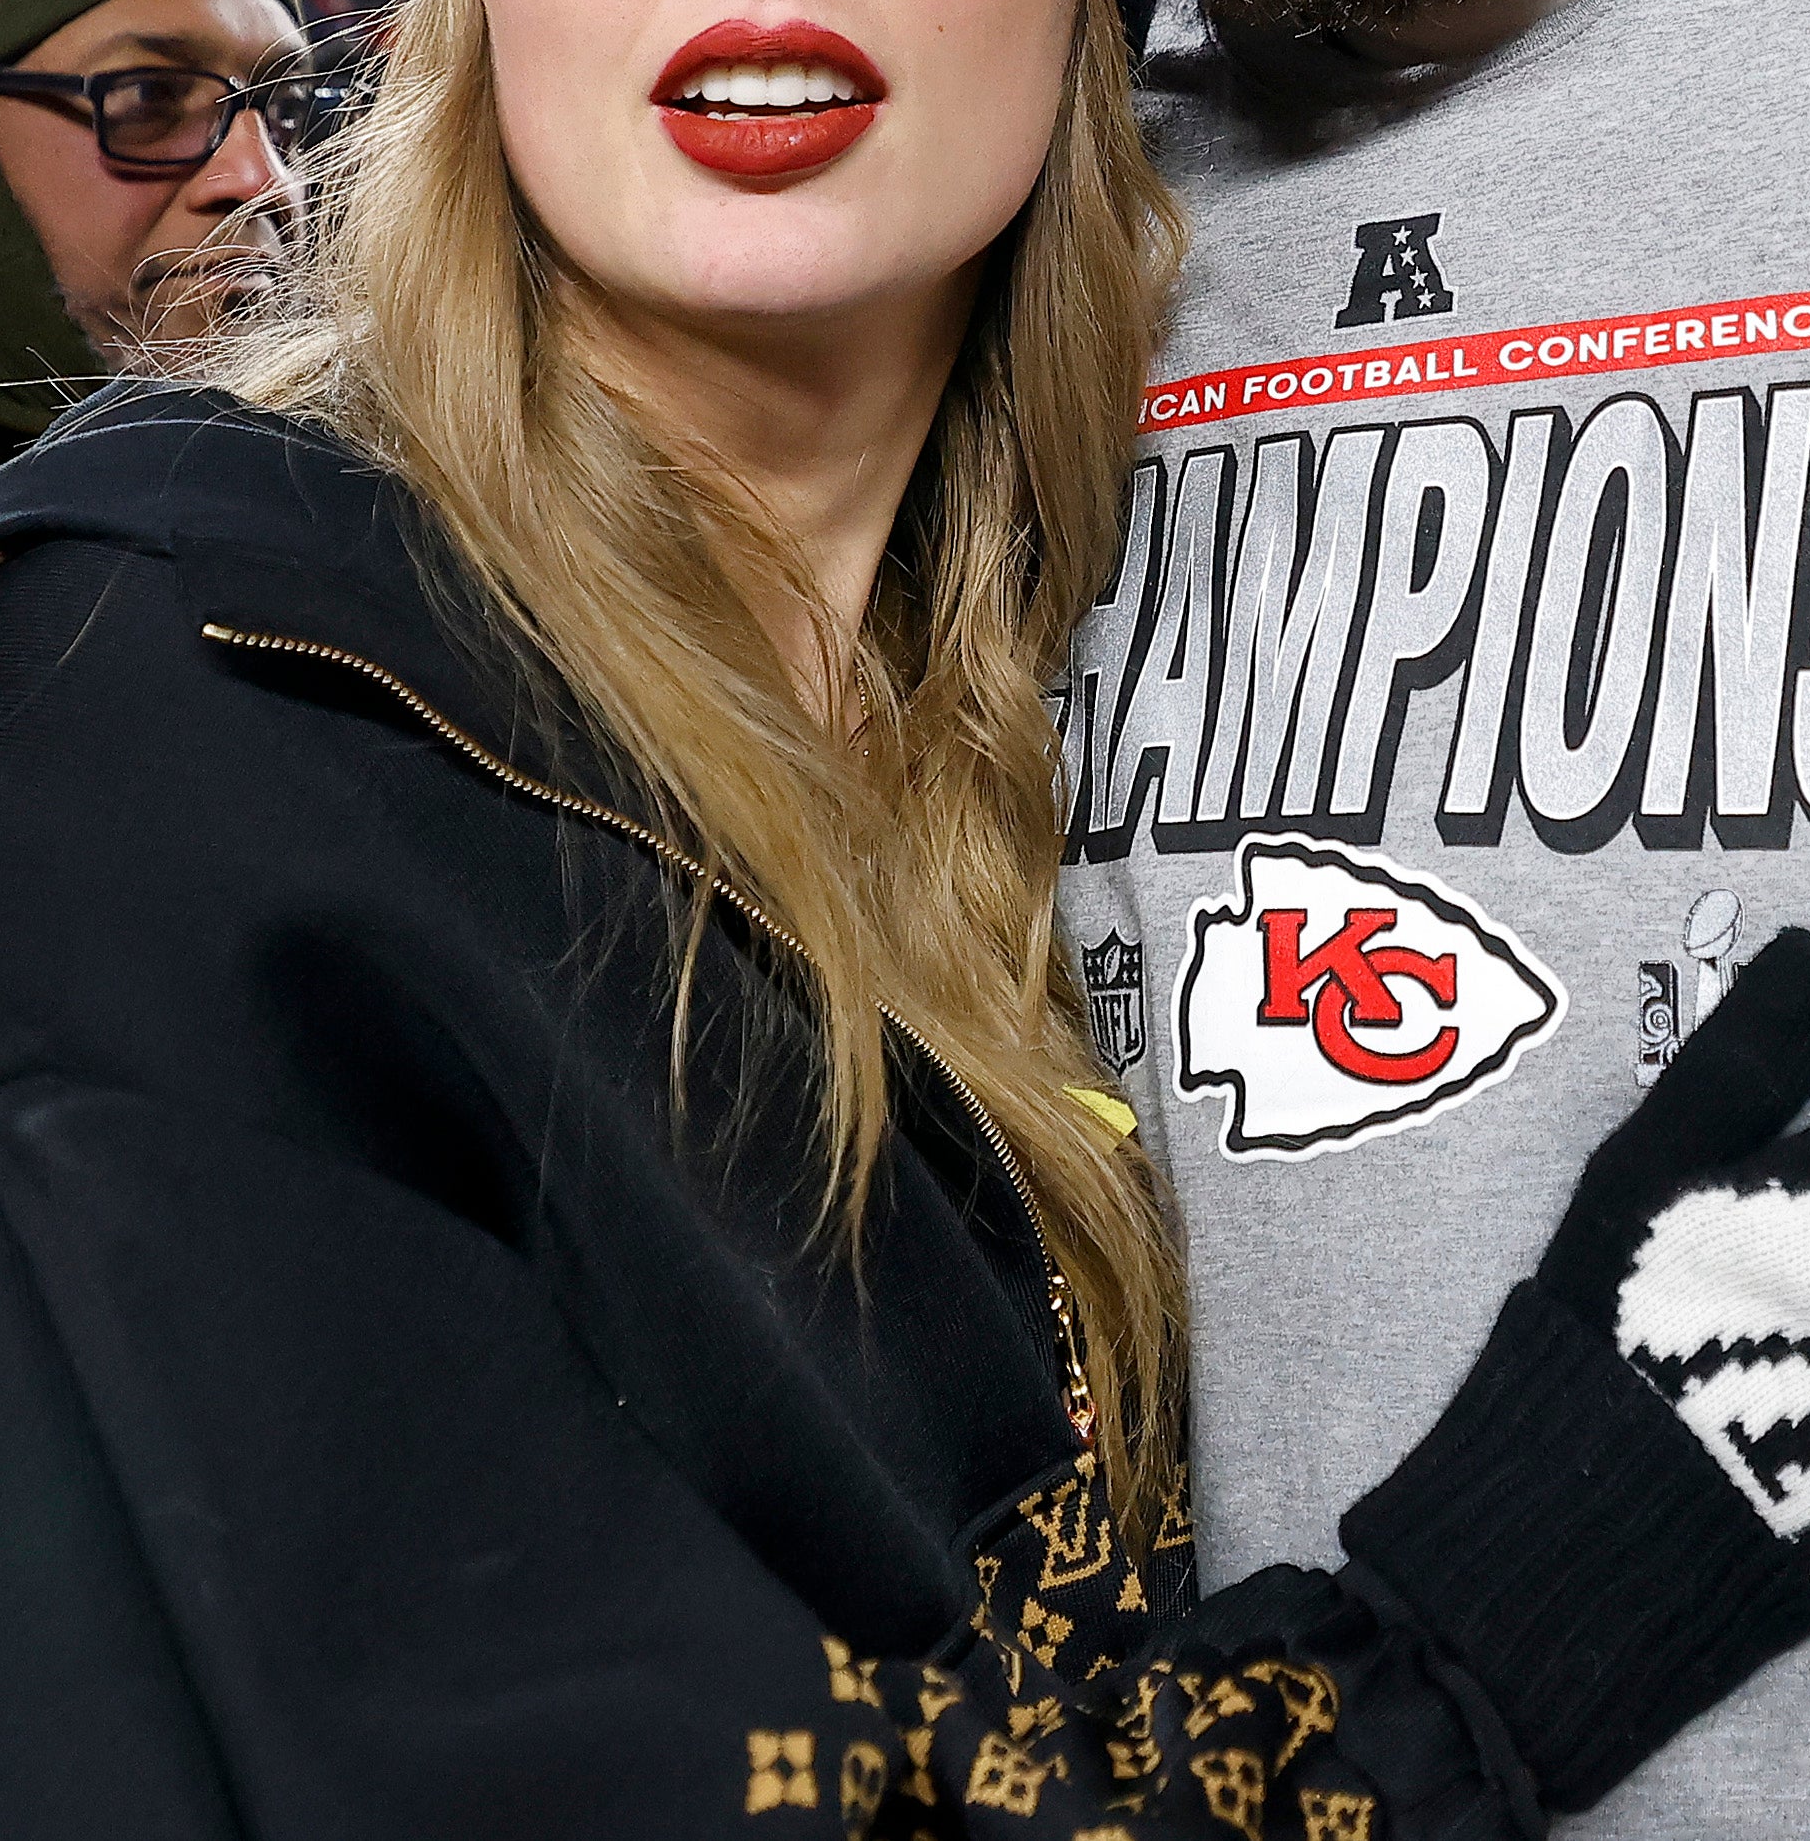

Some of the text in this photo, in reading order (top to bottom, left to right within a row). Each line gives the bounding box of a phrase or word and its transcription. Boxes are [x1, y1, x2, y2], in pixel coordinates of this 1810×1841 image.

[1334, 213, 1455, 328] A
[1137, 382, 1227, 425] ICAN
[1242, 348, 1479, 403] FOOTBALL
[1257, 906, 1461, 1083] KC
